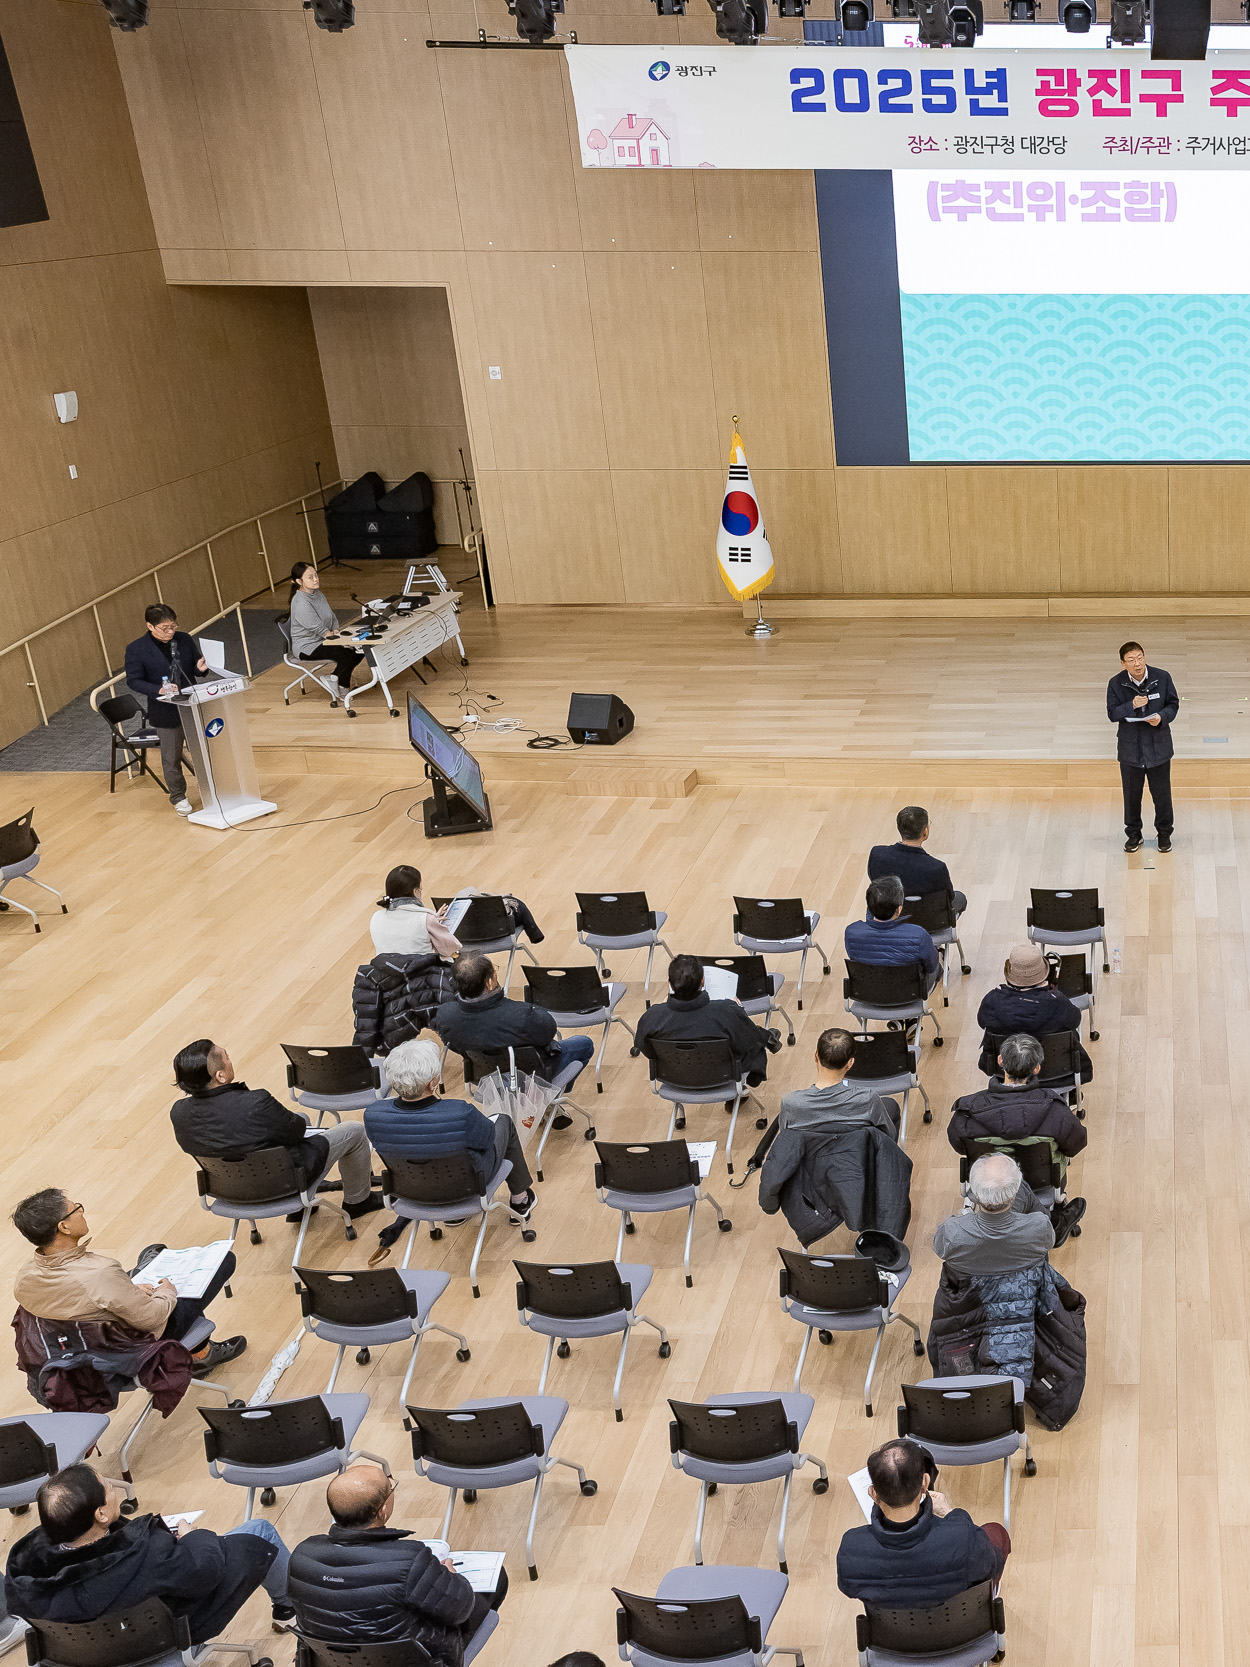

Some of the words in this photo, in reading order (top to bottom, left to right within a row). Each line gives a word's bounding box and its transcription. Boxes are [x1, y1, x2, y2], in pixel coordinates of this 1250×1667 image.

[674, 65, 718, 77] 광진구
[789, 68, 1009, 117] 2025년
[1034, 68, 1185, 118] 광진구
[907, 134, 940, 154] 장소
[952, 135, 1015, 155] 광진구청
[1020, 135, 1068, 155] 대강당
[1102, 135, 1173, 156] 주최/주관
[926, 179, 1178, 223] (추진위·조합)
